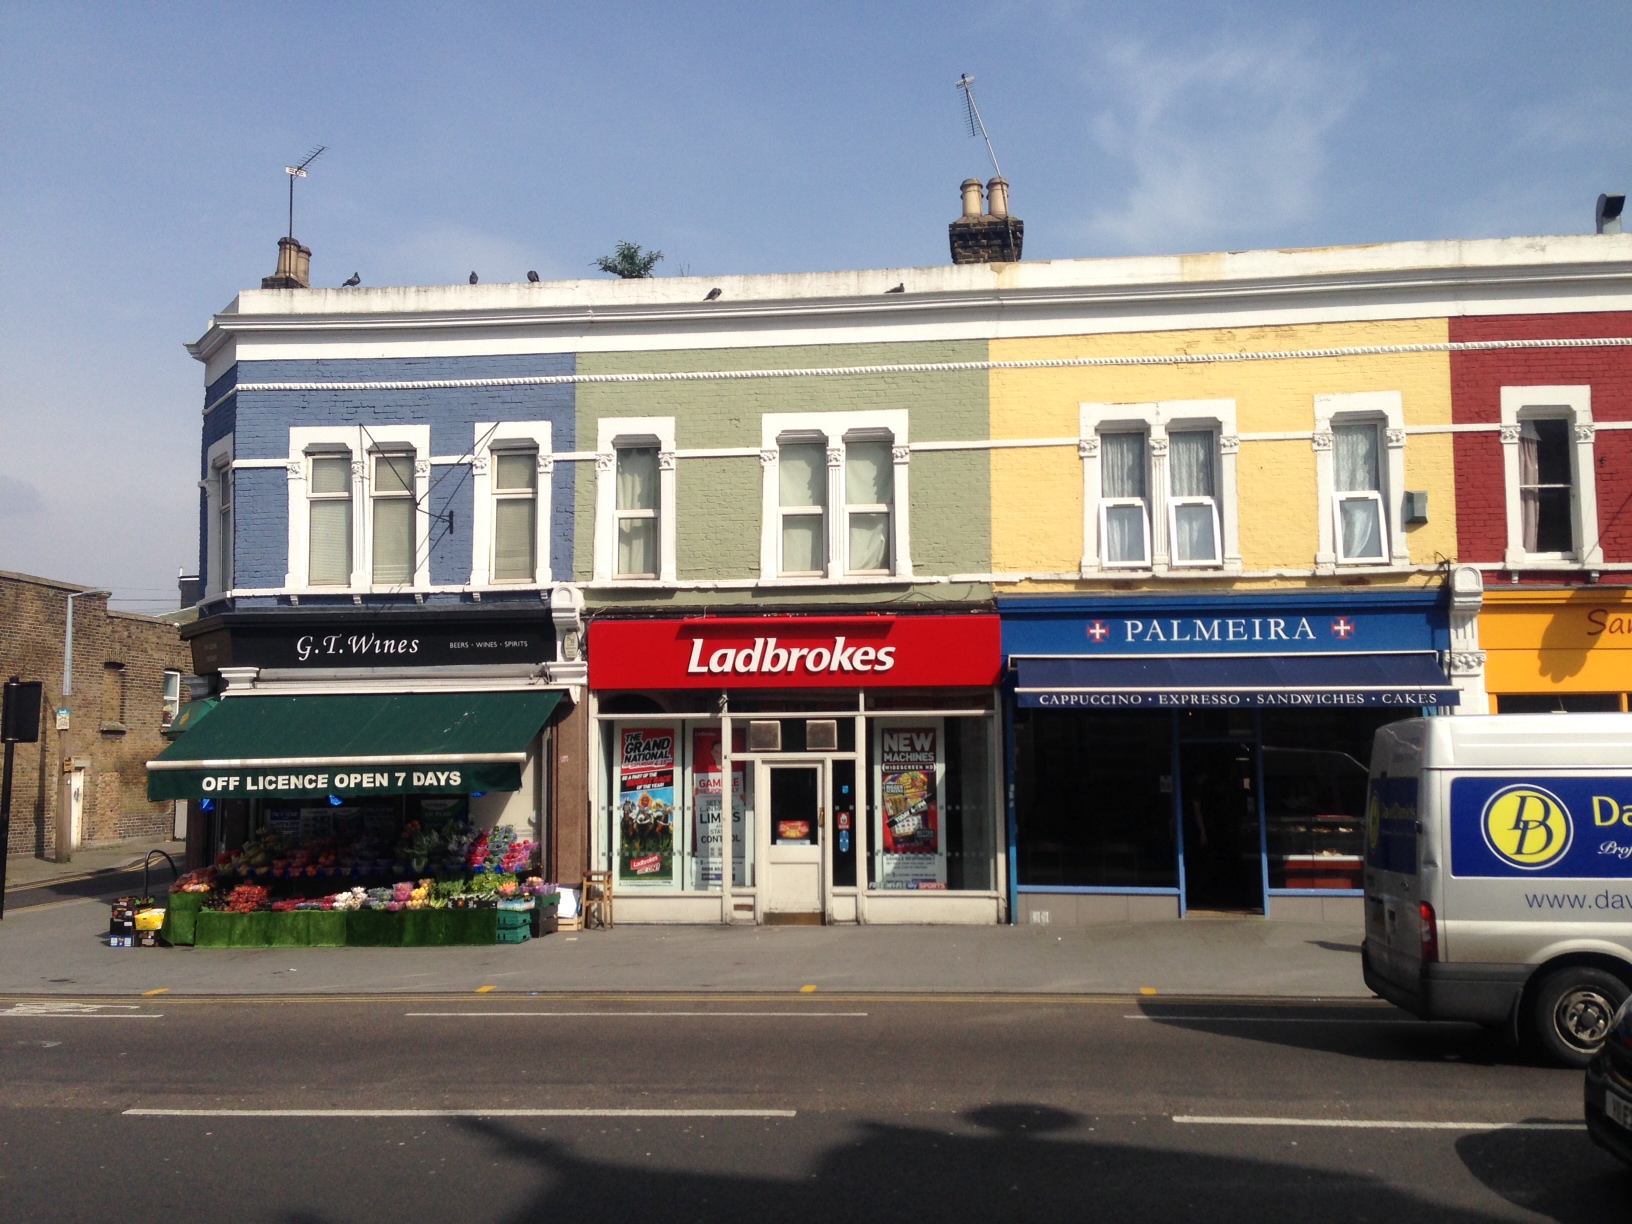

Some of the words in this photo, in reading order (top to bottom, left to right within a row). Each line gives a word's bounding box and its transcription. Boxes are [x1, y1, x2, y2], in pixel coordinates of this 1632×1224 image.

[1123, 617, 1317, 642] PALMEIRA
[504, 640, 528, 648] SPIRITS
[687, 636, 896, 673] Ladbrokes
[1039, 694, 1142, 705] CAPPUCCINO
[1159, 694, 1240, 704] EXPRESSO
[1256, 693, 1365, 704] SANDWICHES
[1382, 693, 1437, 704] CAKES
[625, 732, 643, 742] THE
[883, 733, 934, 752] NEW
[624, 738, 671, 754] GRAND
[883, 752, 935, 762] MACHINES
[201, 776, 240, 791] OFF
[246, 774, 329, 791] LICENCE
[334, 773, 389, 788] OPEN
[394, 772, 406, 787] 7
[413, 771, 462, 786] DAYS
[699, 778, 740, 788] GAME
[700, 811, 741, 824] LIMS
[701, 834, 741, 844] CONTOL
